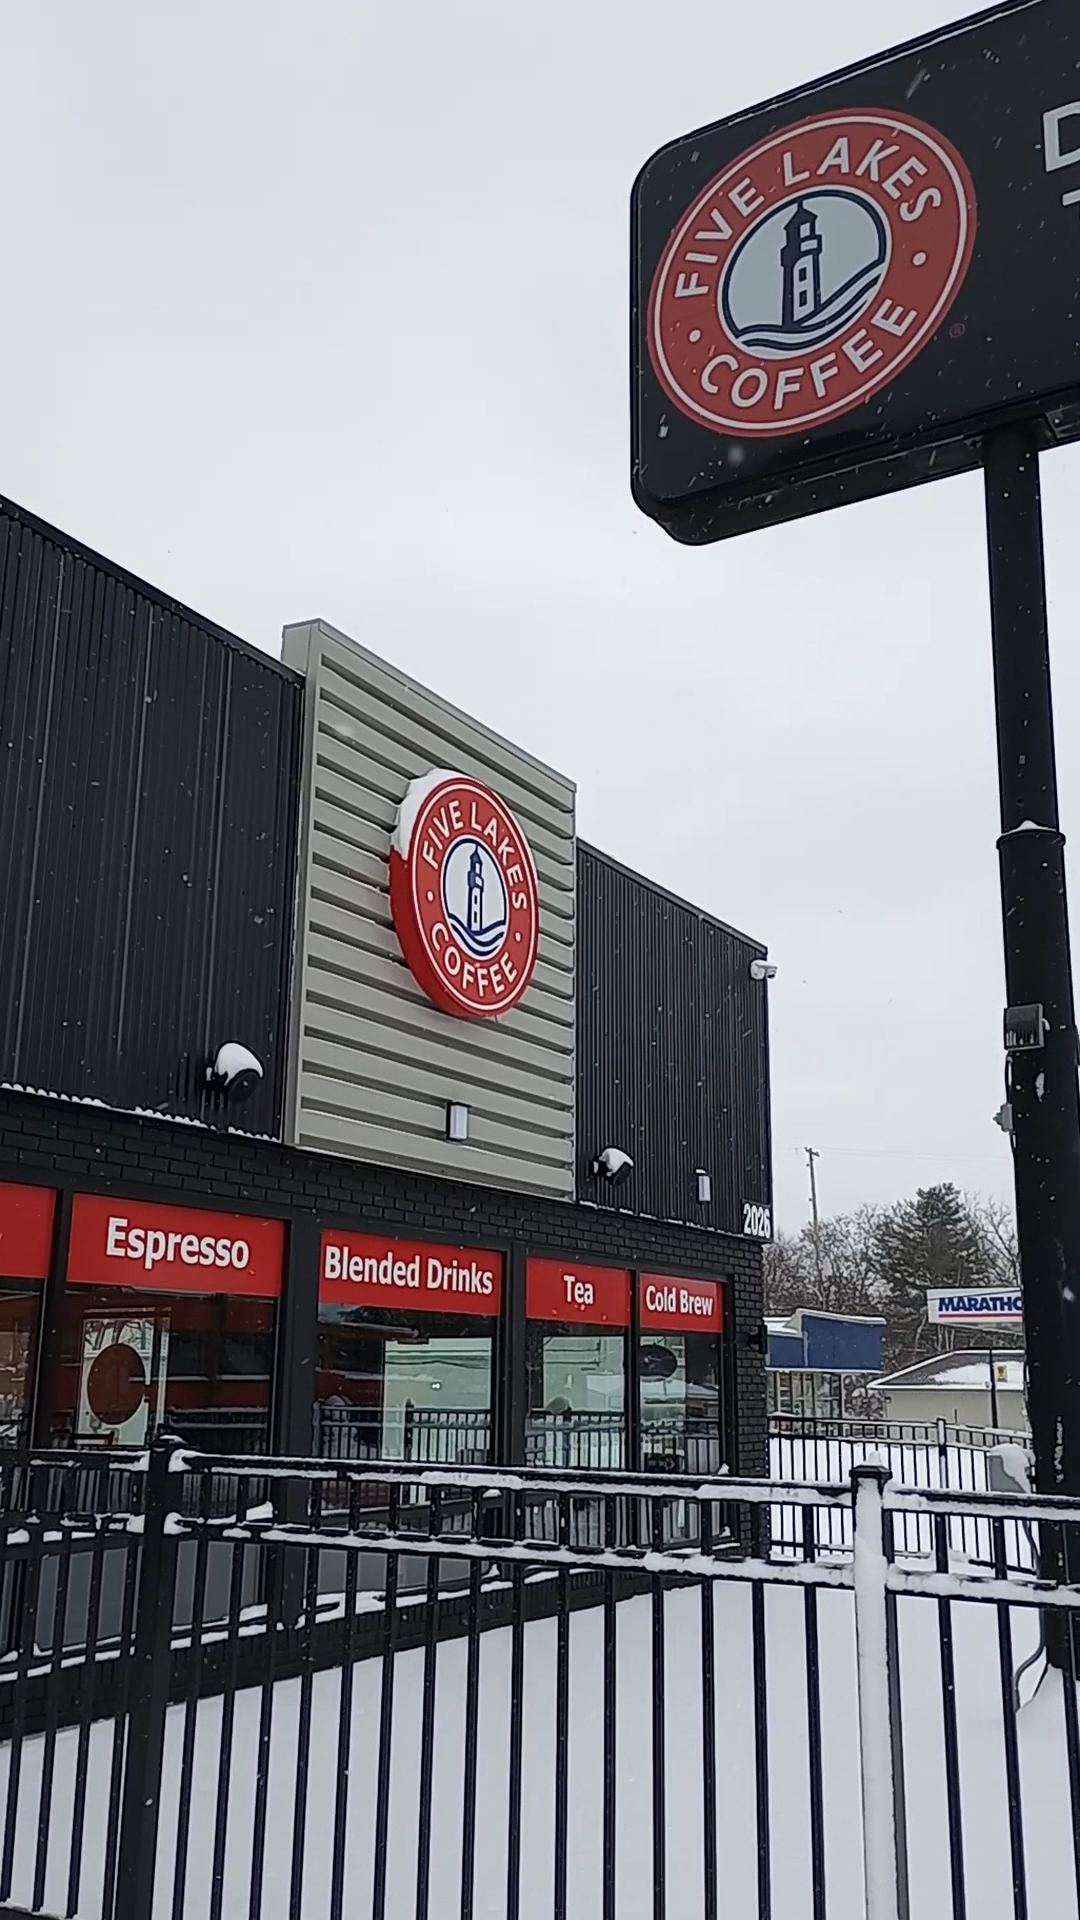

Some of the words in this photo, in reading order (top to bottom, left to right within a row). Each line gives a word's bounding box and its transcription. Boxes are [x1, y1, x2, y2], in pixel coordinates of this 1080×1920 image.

[674, 177, 765, 298] FIVE
[782, 137, 941, 222] LAKES
[700, 299, 918, 410] COFFEE
[422, 800, 464, 870] FIVE
[470, 802, 527, 910] LAKES
[431, 922, 518, 997] COFFEE
[105, 1217, 250, 1270] Espresso
[743, 1203, 771, 1239] 2026
[324, 1245, 420, 1288] Blended
[427, 1258, 493, 1295] Drinks
[563, 1275, 594, 1305] Tea
[645, 1285, 676, 1312] Cold
[680, 1290, 714, 1316] Brew
[938, 1296, 1023, 1311] MARATHO
